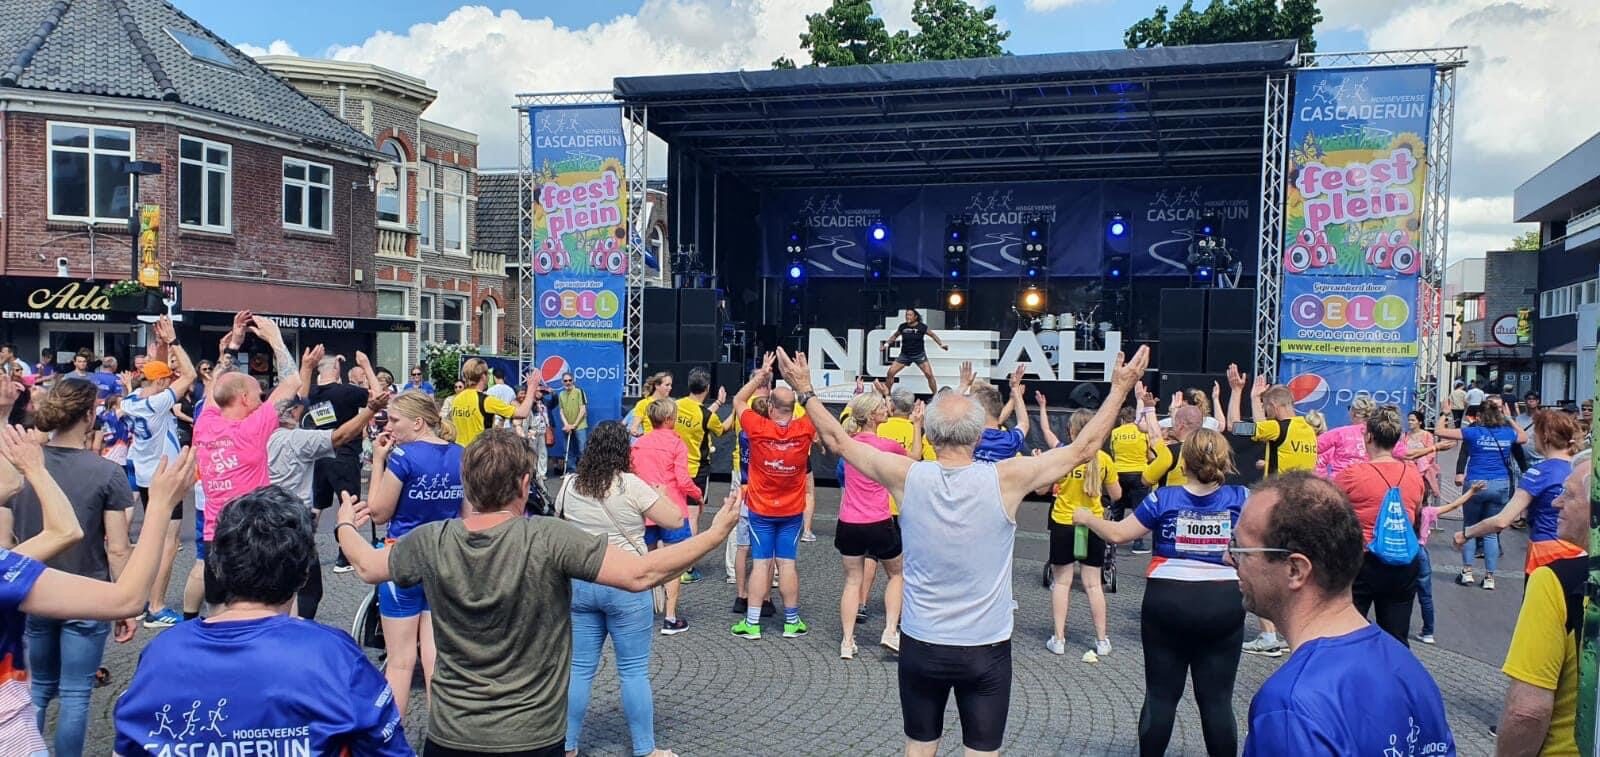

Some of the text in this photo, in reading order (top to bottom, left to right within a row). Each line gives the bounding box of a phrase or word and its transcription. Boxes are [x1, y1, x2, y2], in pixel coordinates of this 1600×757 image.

[1300, 103, 1425, 121] CASCADERUN
[536, 135, 622, 148] CASCADERUN
[1301, 153, 1411, 193] feest
[543, 175, 616, 208] feest
[1308, 187, 1409, 231] plein
[550, 202, 617, 239] plein
[28, 282, 111, 310] Ada
[545, 296, 610, 311] CELL
[2, 311, 41, 319] EETHUIS
[52, 313, 105, 321] GRILLROOM
[1300, 301, 1396, 320] CELL
[270, 316, 355, 329] THUIS & GRILLROOM
[1298, 329, 1401, 340] evenementen
[1288, 343, 1410, 354] www.cell-evenementen.nl
[574, 364, 620, 382] pepsi
[1187, 524, 1221, 535] 10033
[233, 726, 310, 739] HOOGEVEENSE
